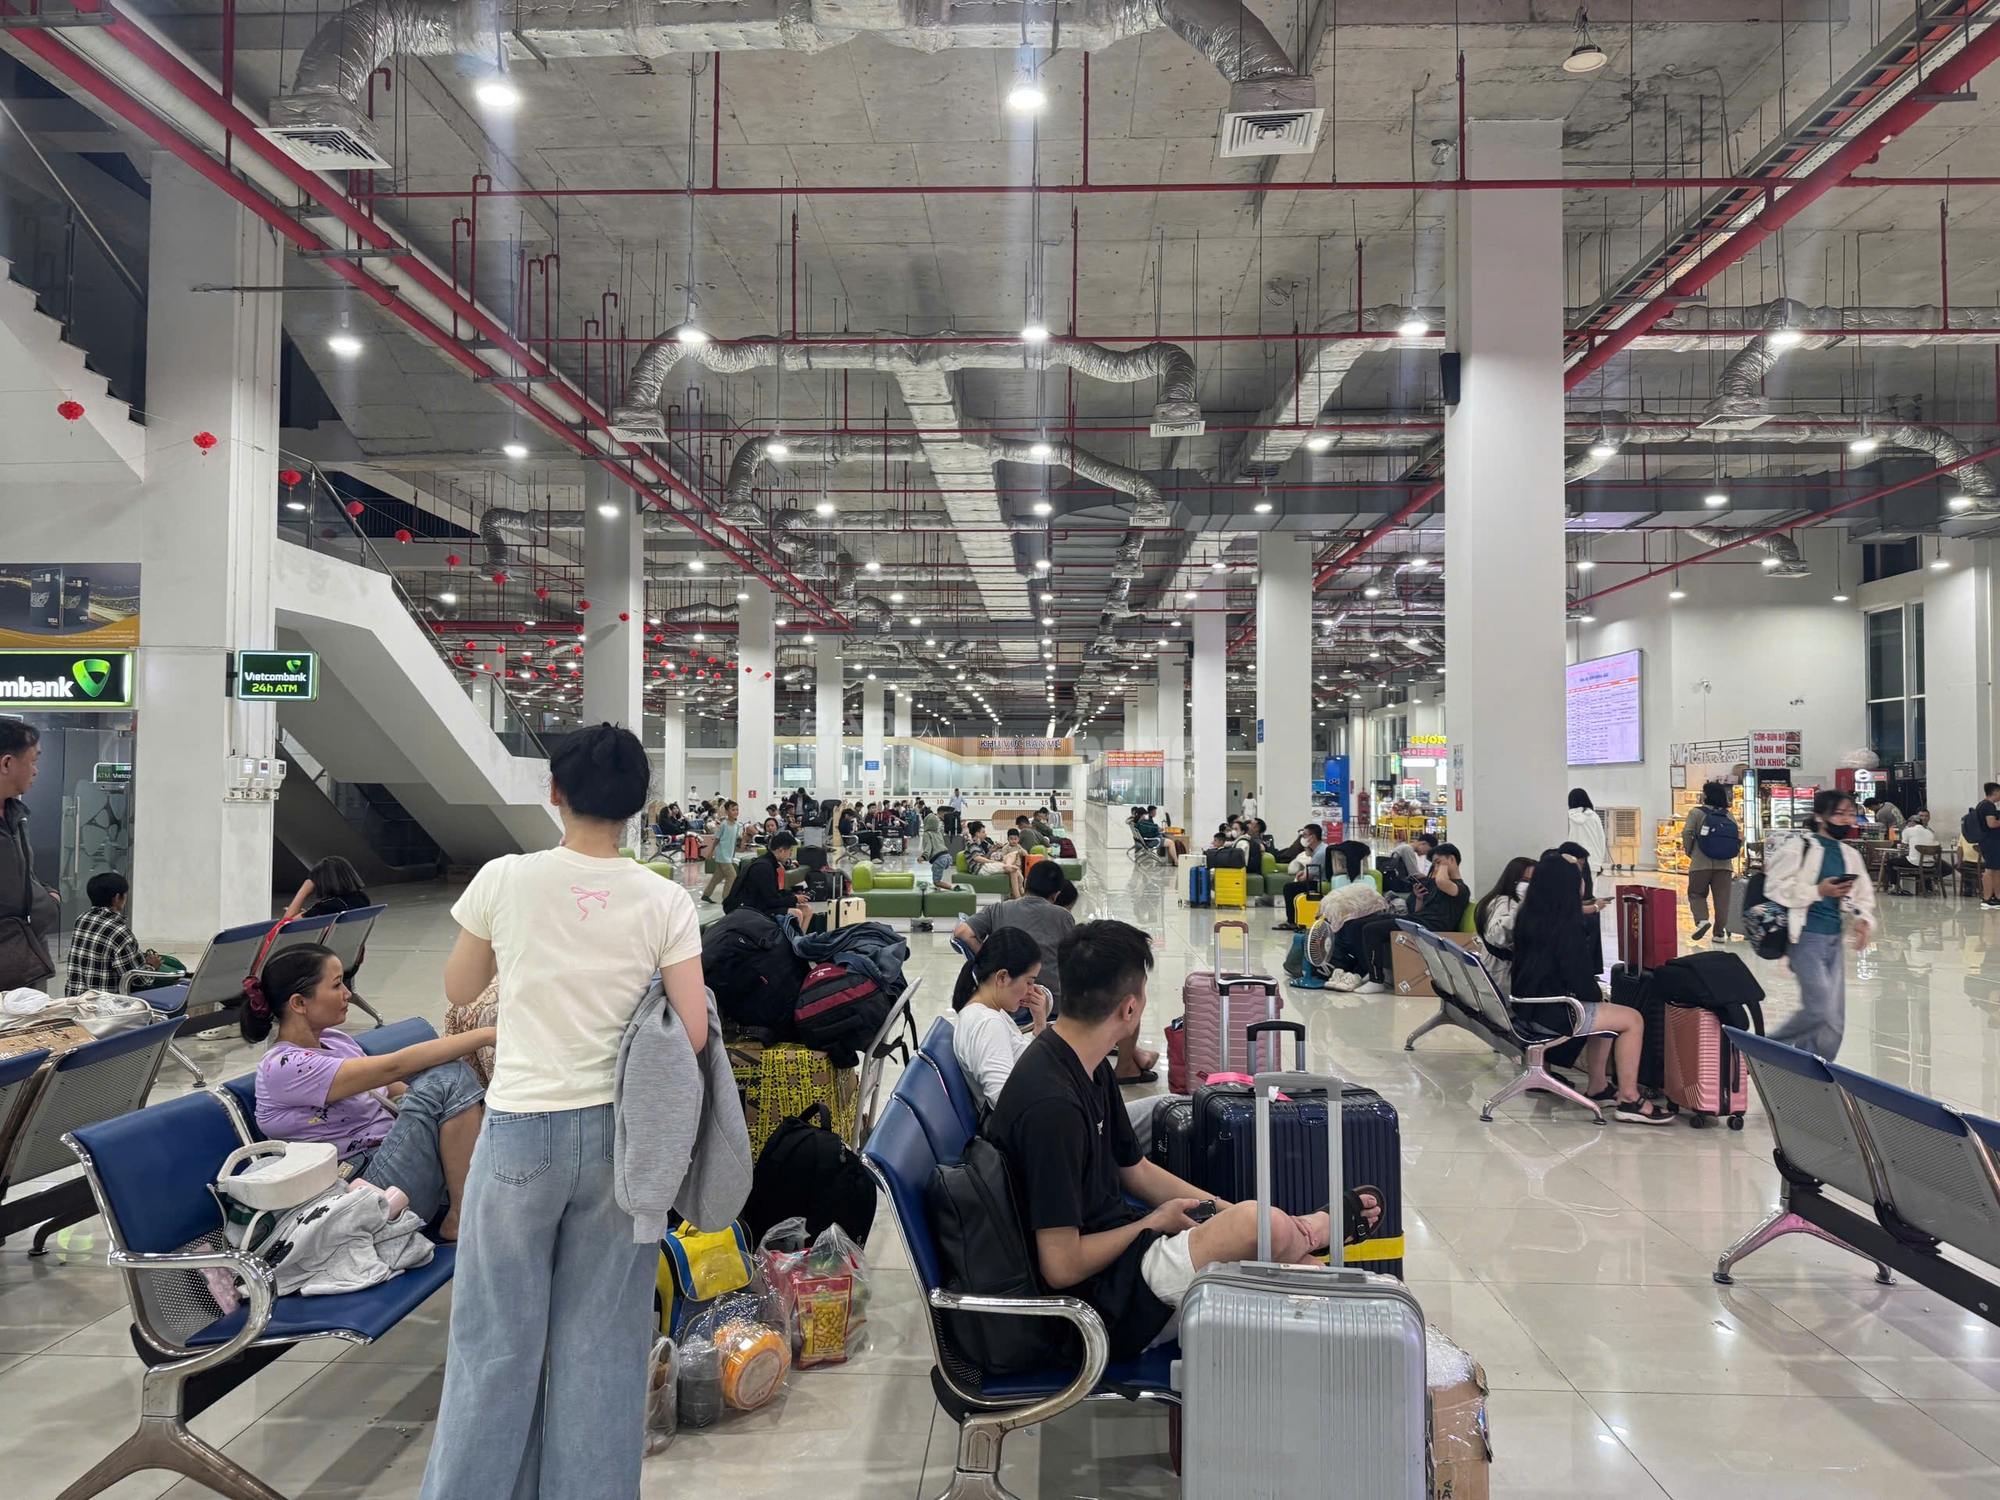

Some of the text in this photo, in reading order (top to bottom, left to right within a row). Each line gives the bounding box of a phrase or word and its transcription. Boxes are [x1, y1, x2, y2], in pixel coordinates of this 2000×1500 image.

[244, 671, 307, 682] Vietcombank
[251, 683, 298, 693] 24h ATM
[980, 740, 1001, 749] KHU
[1754, 743, 1774, 753] BÁNH
[1767, 755, 1786, 766] KHÚC
